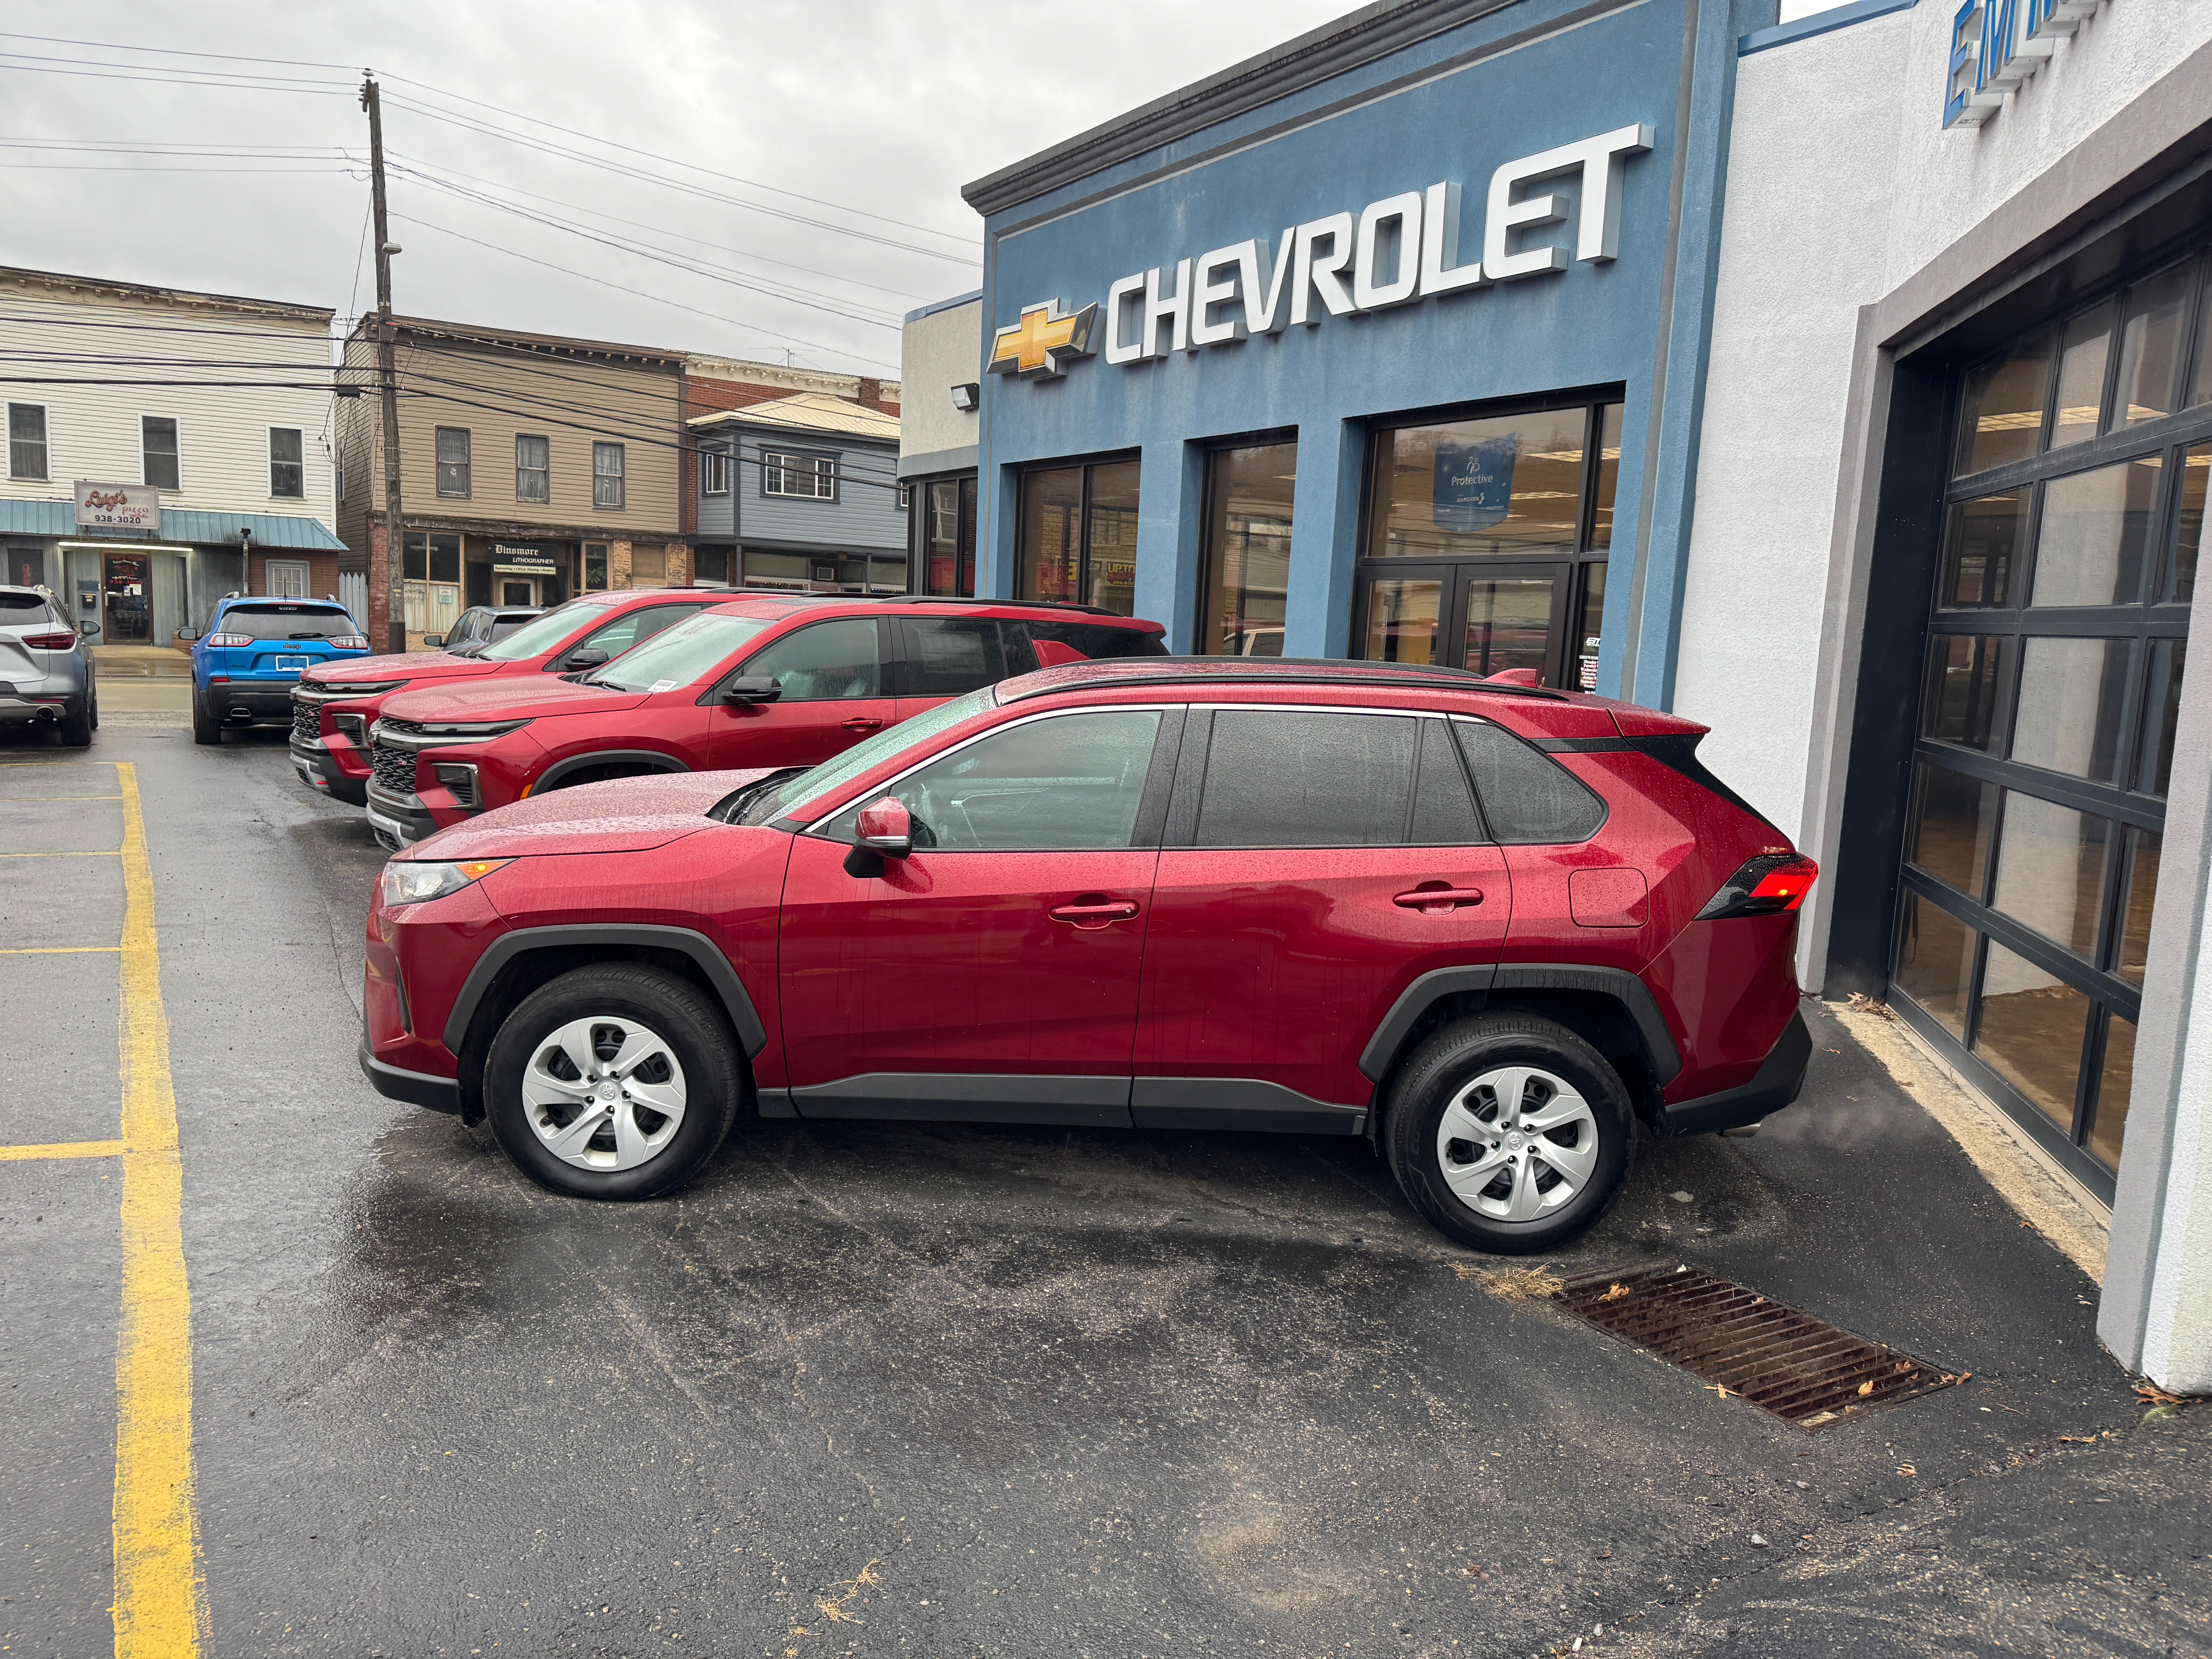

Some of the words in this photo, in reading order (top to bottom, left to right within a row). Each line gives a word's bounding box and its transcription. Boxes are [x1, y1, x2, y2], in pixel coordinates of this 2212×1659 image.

[1105, 122, 1643, 366] CHEVROLET
[1451, 474, 1493, 486] Protective
[85, 489, 128, 512] Luigi's
[94, 515, 141, 524] 938-3020
[495, 544, 538, 555] Dinsmore
